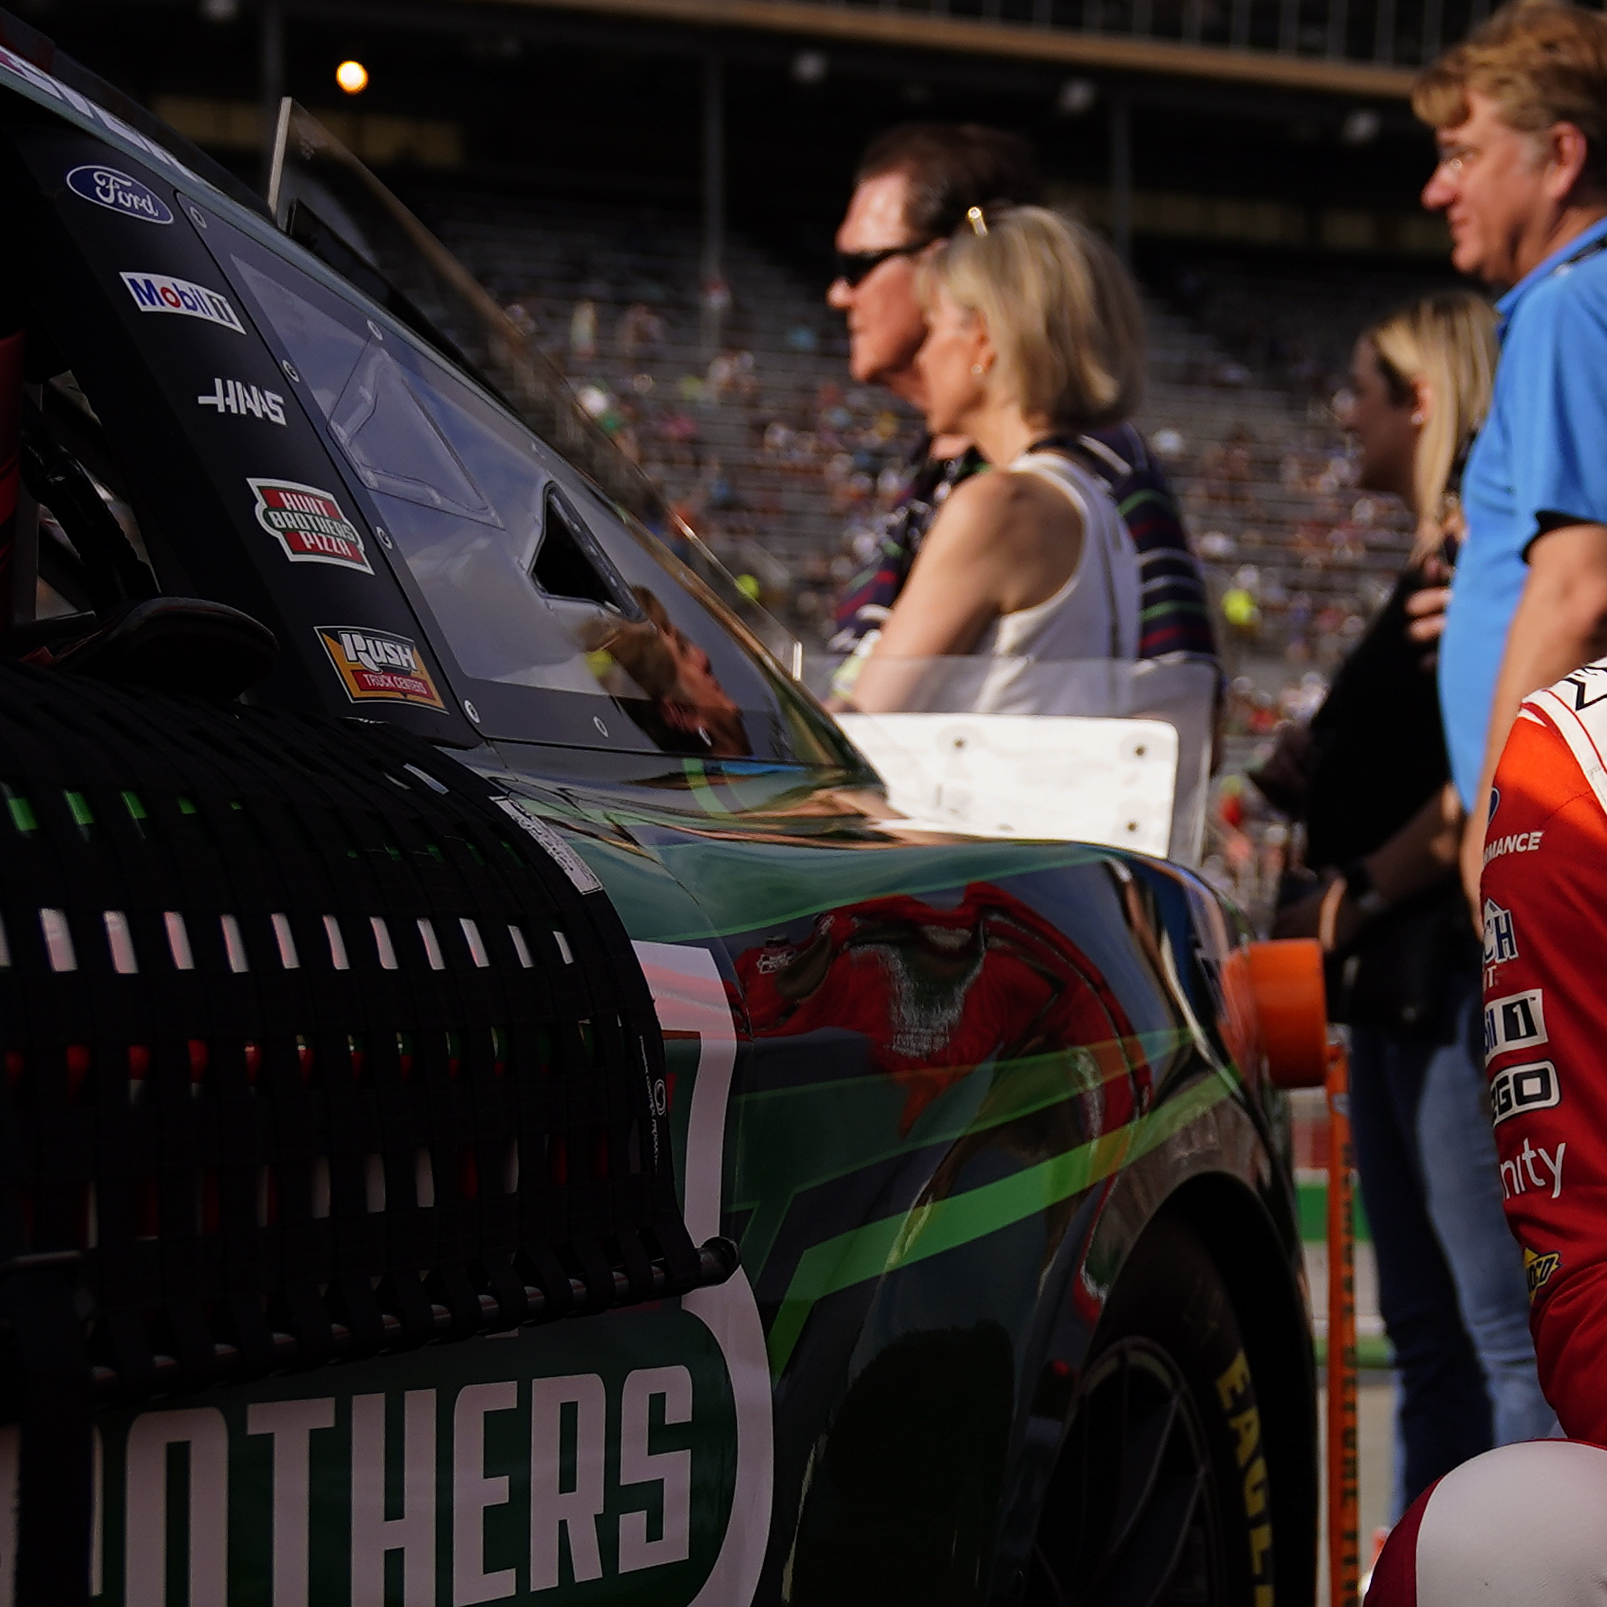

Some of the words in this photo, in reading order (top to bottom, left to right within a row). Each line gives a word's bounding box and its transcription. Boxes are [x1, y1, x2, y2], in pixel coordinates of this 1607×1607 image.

[93, 170, 160, 217] Ford
[127, 277, 214, 317] Mobil
[197, 377, 288, 427] HAAS
[278, 491, 331, 518] HUNT
[266, 510, 357, 543] BROTHERS
[298, 531, 353, 558] PIZZA
[362, 673, 394, 688] TRUCK
